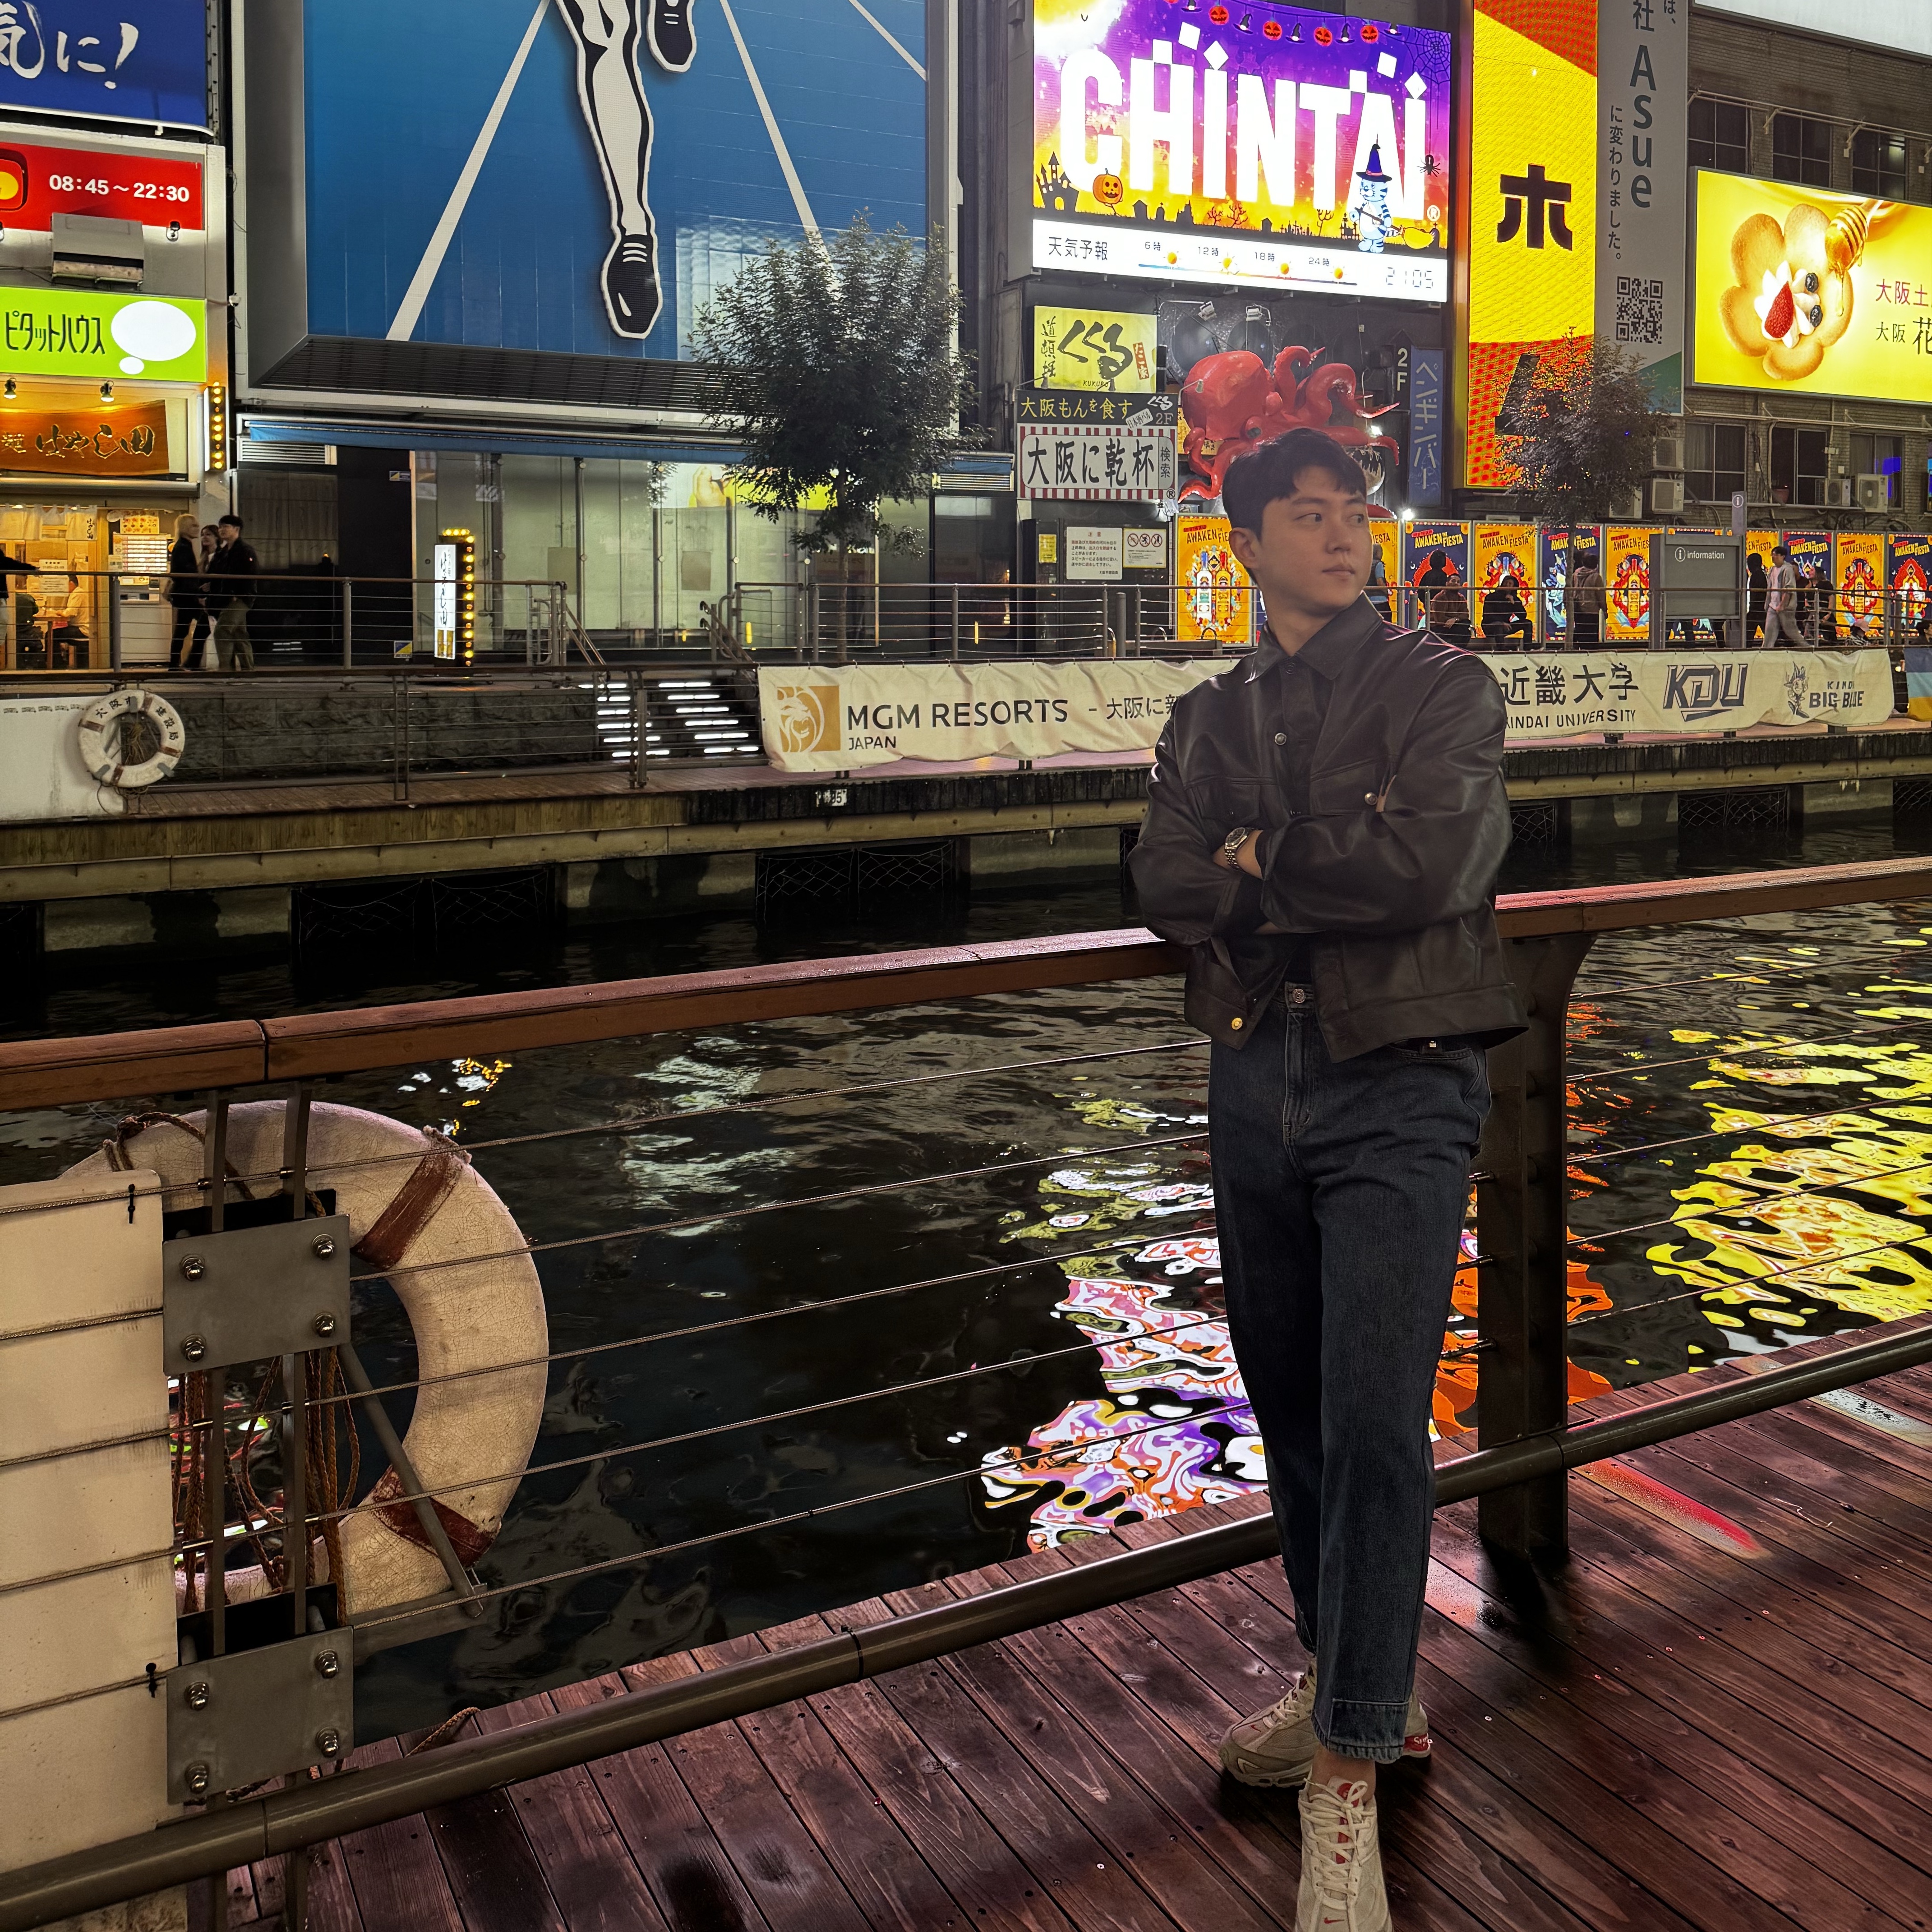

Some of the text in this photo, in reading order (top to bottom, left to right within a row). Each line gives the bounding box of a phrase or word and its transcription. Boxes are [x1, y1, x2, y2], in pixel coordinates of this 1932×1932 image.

[1060, 39, 1427, 221] CHINTAI
[1629, 44, 1656, 208] Asue
[1608, 105, 1623, 260] に変わりました。
[1048, 236, 1108, 261] 天気予報
[1876, 278, 1932, 308] 大阪土
[5, 310, 106, 355] ピタットハウス
[1041, 316, 1058, 378] 道頓堀
[1057, 319, 1133, 380] くくる
[1021, 397, 1133, 419] 大阪もんを食す
[1147, 396, 1173, 410] くくる
[1156, 413, 1173, 425] 2F
[1414, 362, 1439, 490] ペンギンバー
[1027, 437, 1154, 488] 大阪に乾杯
[1160, 446, 1171, 478] 検索
[1187, 529, 1217, 544] AWAKEN
[1218, 532, 1229, 543] FIE
[1372, 533, 1390, 544] IESTA
[1415, 533, 1443, 548] AWAKEN
[1442, 534, 1463, 547] FIESTA
[1483, 534, 1508, 549] AWAKEN
[1509, 535, 1529, 548] FIESTA
[1577, 537, 1596, 550] FIESTA
[1614, 538, 1637, 552] AWAKEN
[1687, 550, 1725, 559] information
[1756, 542, 1772, 552] FIESTA
[1790, 542, 1812, 556] AWAKEN
[1812, 543, 1828, 554] FIESTA
[1842, 542, 1863, 556] AWAKEN
[1863, 543, 1878, 555] FIESTA
[1895, 544, 1915, 557] AWAKEN
[1914, 544, 1930, 556] FIESTA
[1500, 662, 1639, 705] 近畿大学
[1809, 692, 1838, 708] BIG
[848, 699, 1068, 731] MGM RESORTS
[1557, 709, 1636, 727] UNIVERSITY
[848, 736, 896, 750] JAPAN
